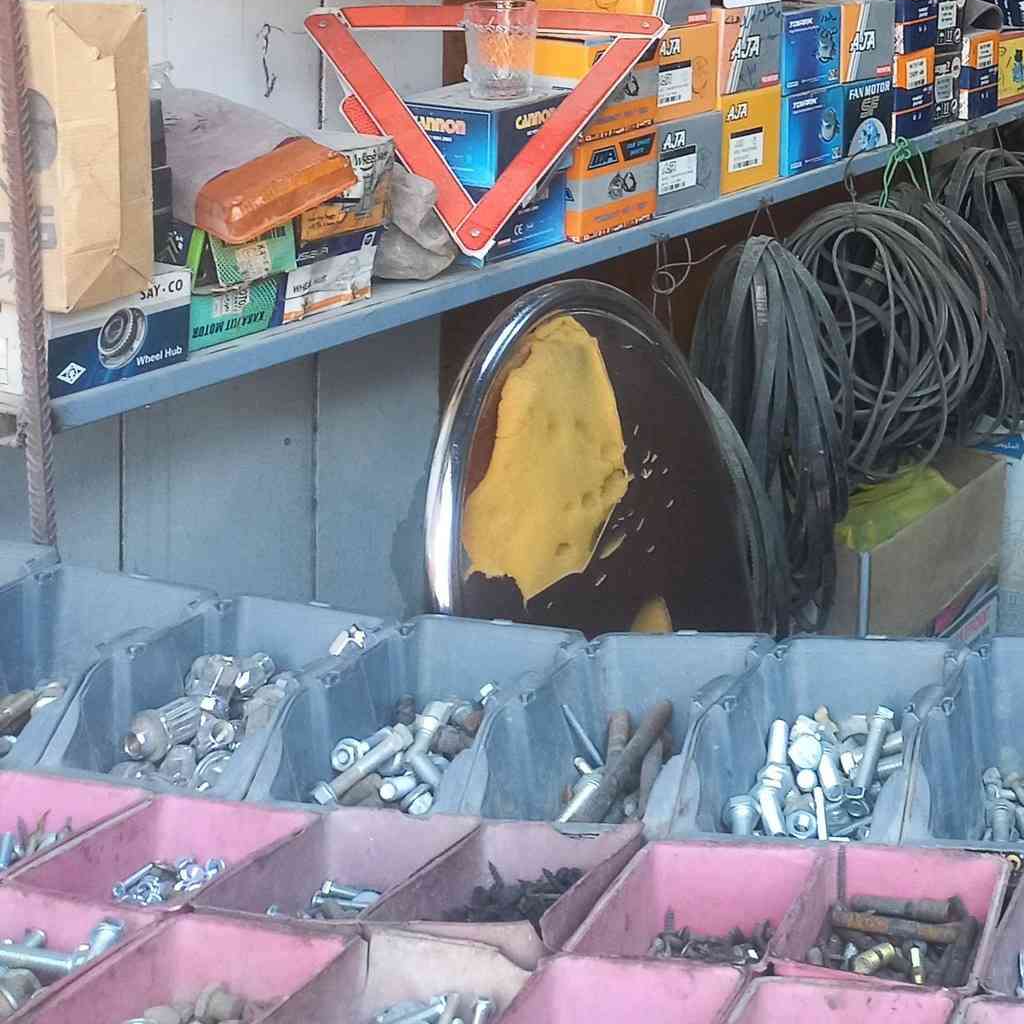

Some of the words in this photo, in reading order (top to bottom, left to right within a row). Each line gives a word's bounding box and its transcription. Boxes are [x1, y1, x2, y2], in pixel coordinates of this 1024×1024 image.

[659, 36, 681, 57] AJA
[730, 34, 761, 61] AJA
[849, 29, 876, 53] AJA
[849, 87, 864, 101] FAN
[865, 80, 891, 97] MOTOR
[726, 101, 749, 122] AJA
[662, 128, 687, 152] AJA
[192, 320, 225, 339] MOTOR
[135, 349, 164, 367] Wheel
[165, 345, 183, 360] Hub
